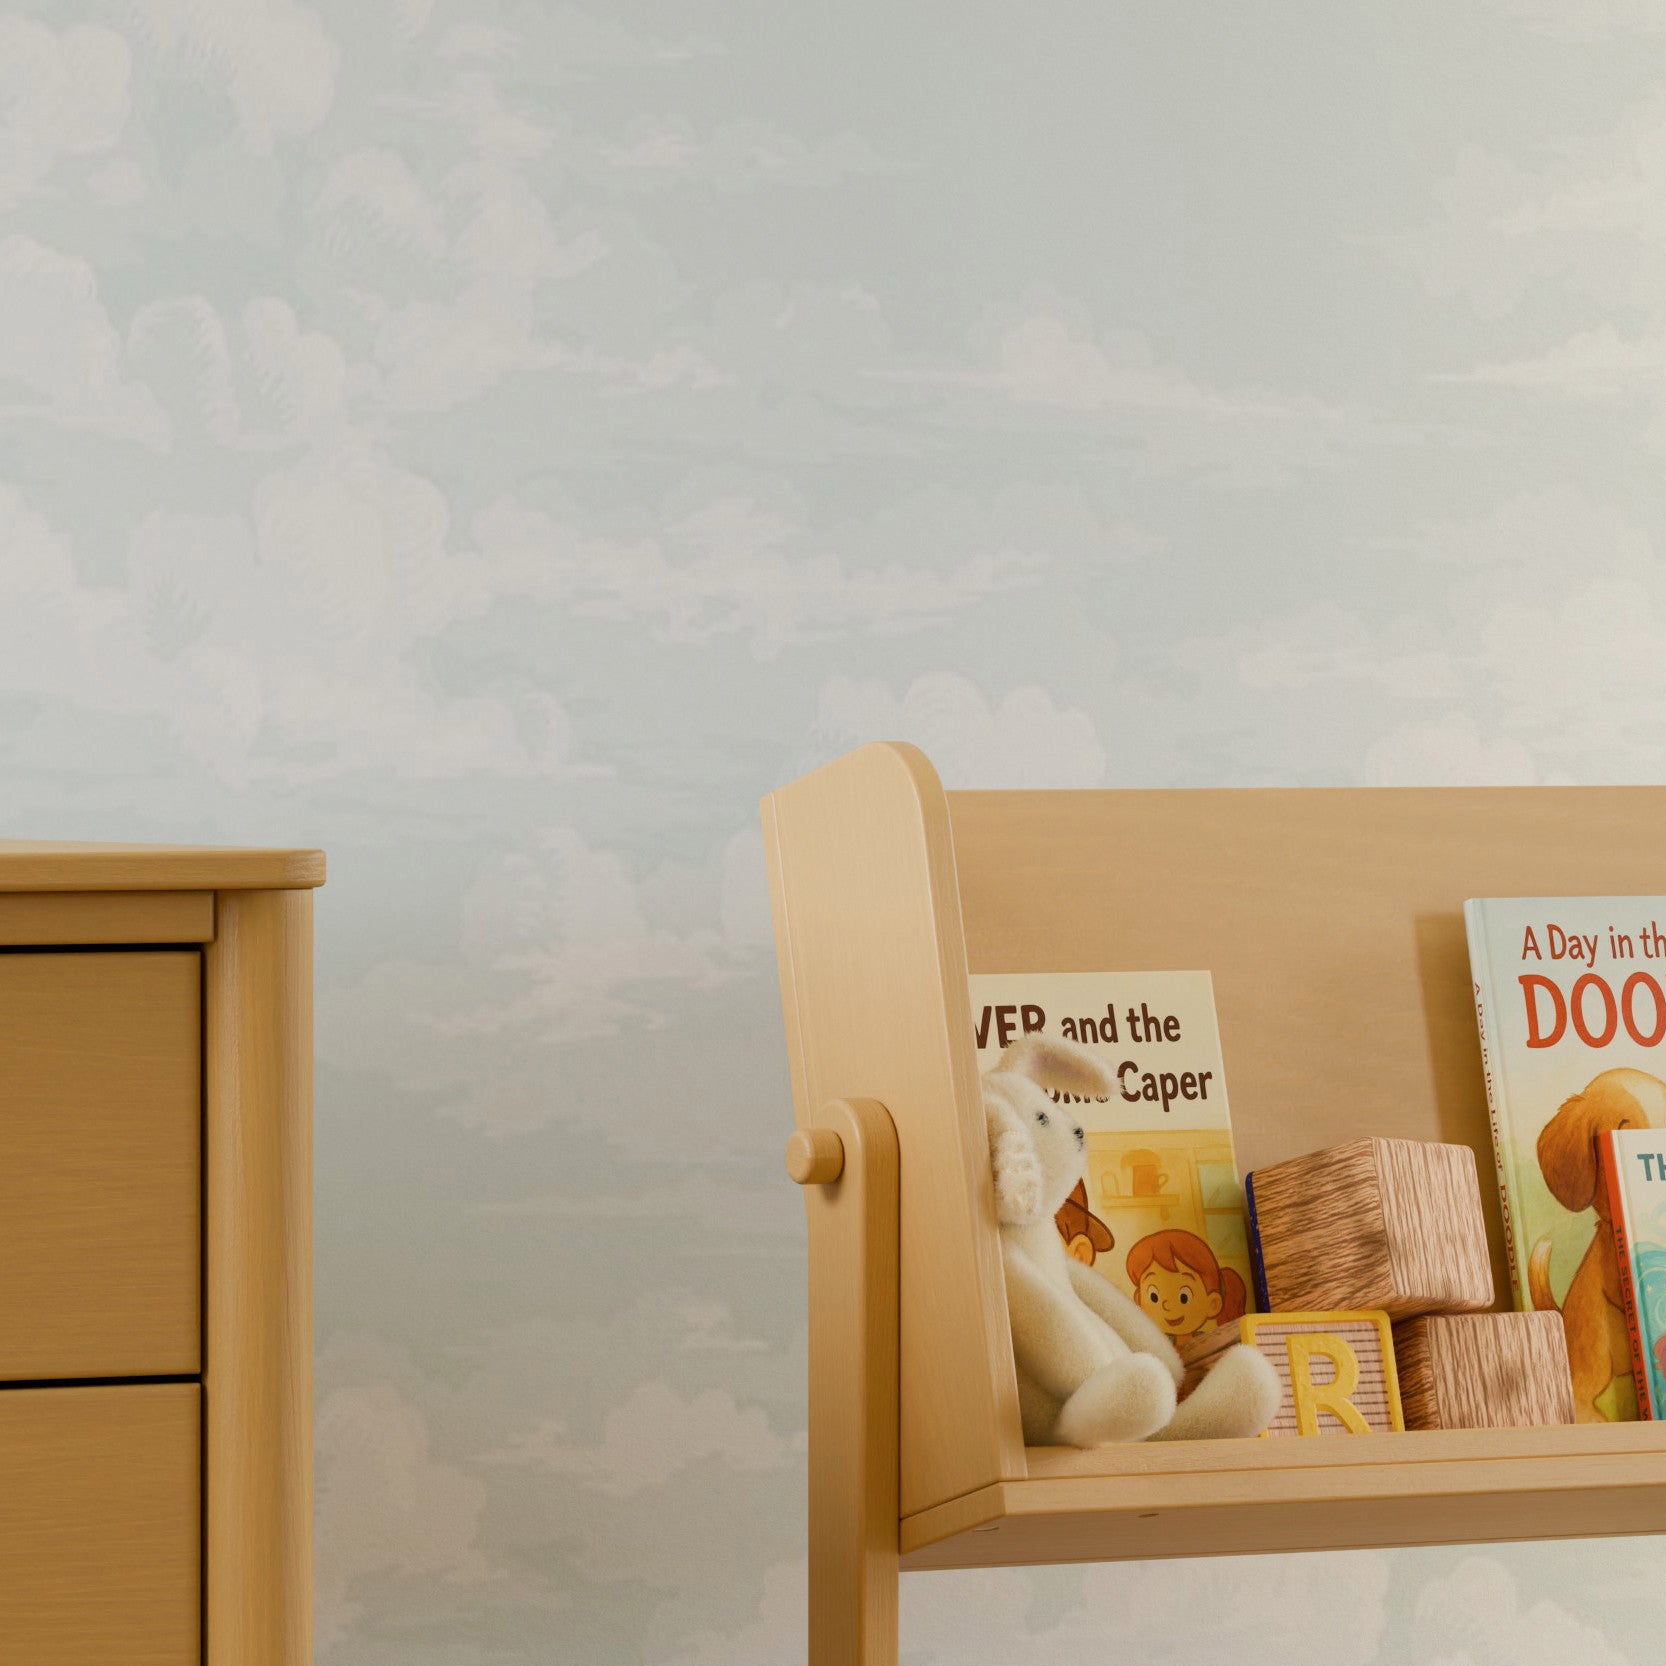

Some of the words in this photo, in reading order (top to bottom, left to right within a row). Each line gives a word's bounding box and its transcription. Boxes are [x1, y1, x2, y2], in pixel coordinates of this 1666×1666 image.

[1522, 925, 1542, 961] A
[1547, 923, 1598, 968] Day
[1610, 925, 1633, 959] in
[1061, 1003, 1118, 1043] and
[1126, 1003, 1181, 1043] the
[1117, 1061, 1212, 1113] Caper
[1500, 1185, 1519, 1293] DOODLE
[1616, 1227, 1626, 1257] THE
[1621, 1266, 1637, 1332] SECRET
[1632, 1339, 1642, 1363] OF
[1286, 1332, 1373, 1435] R
